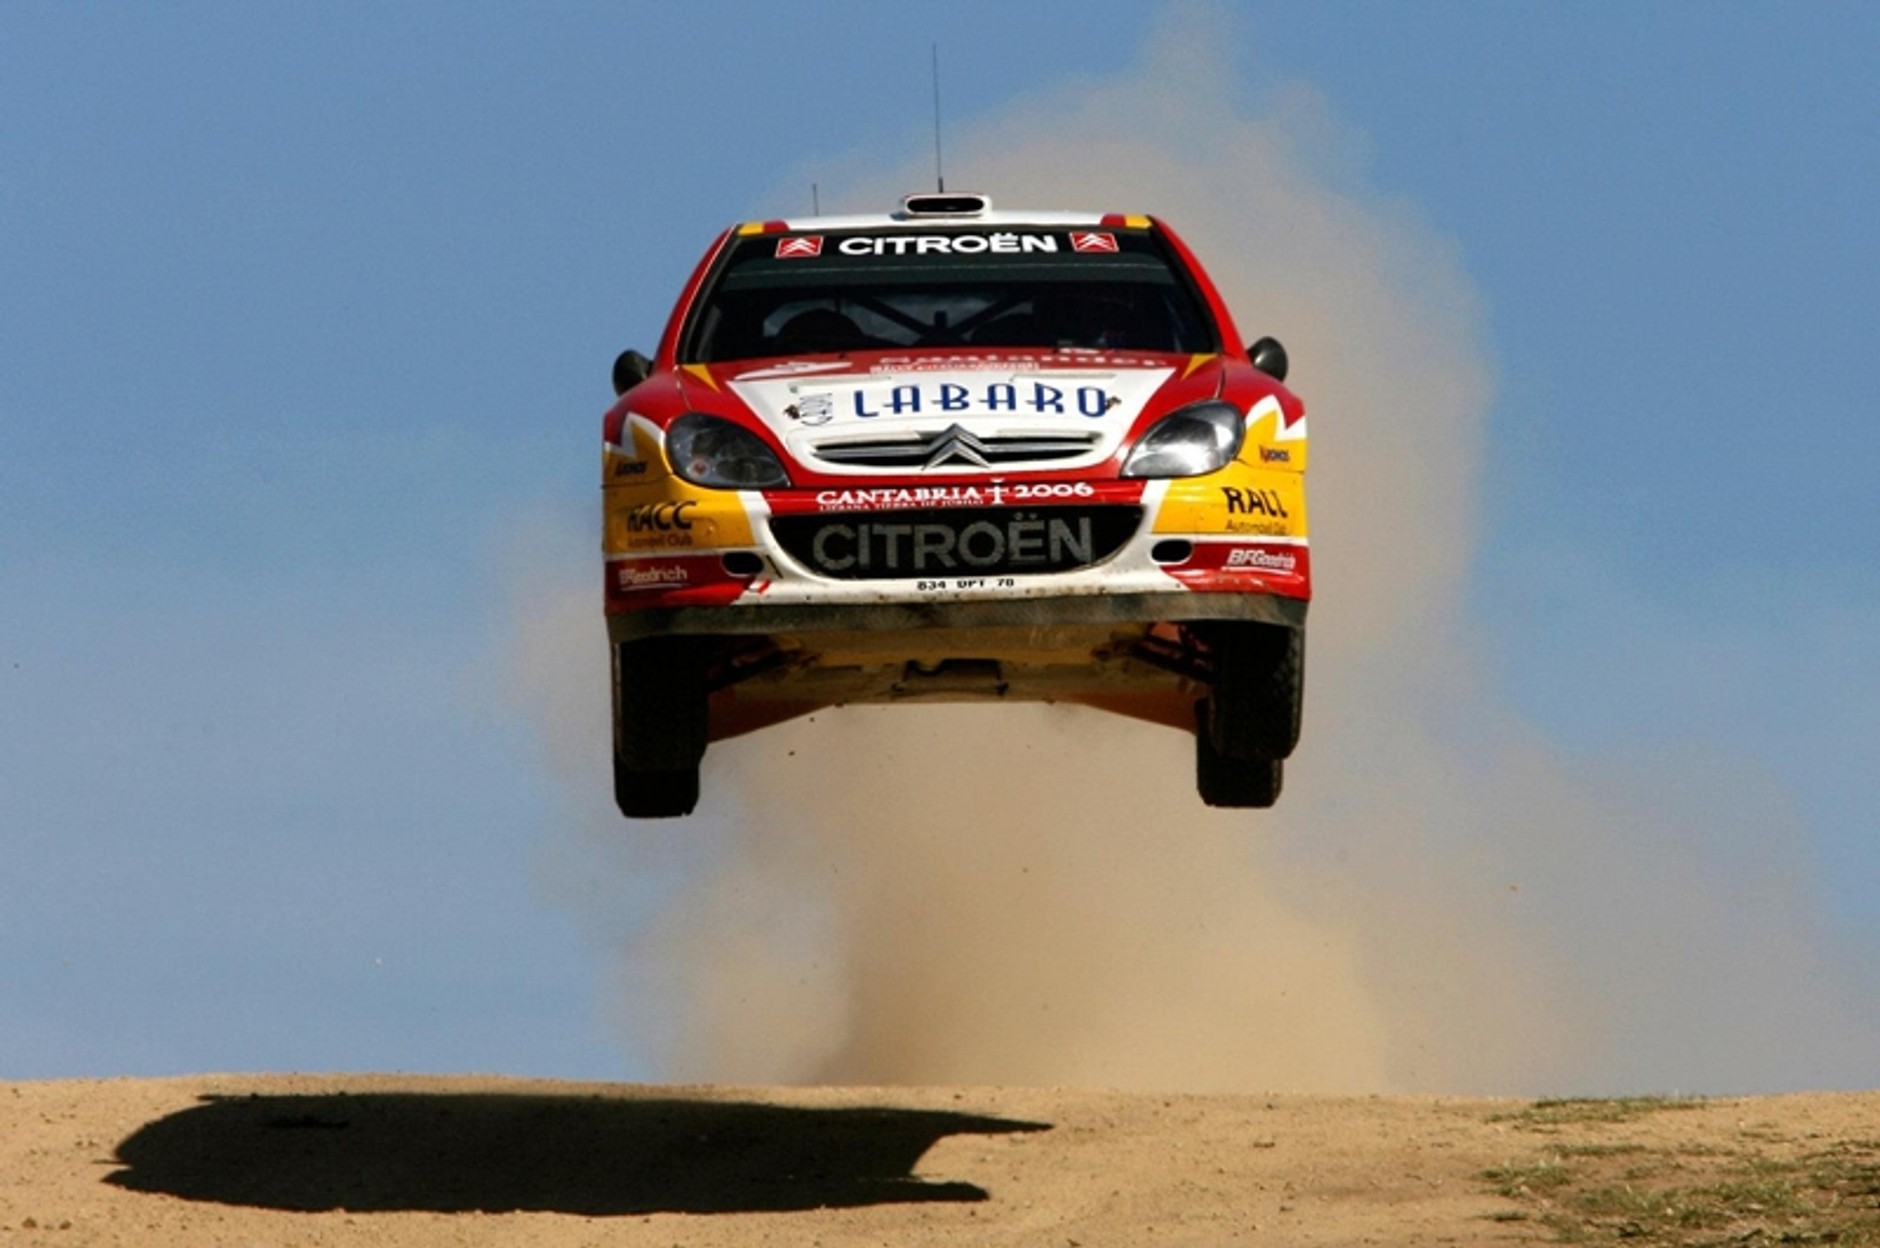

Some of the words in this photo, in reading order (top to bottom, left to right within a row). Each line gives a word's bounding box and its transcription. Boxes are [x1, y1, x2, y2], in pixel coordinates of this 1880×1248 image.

[839, 232, 1058, 255] CITROËN
[853, 382, 1106, 418] LABARO
[816, 486, 982, 505] CANTABRIA
[1014, 481, 1094, 498] 2006
[812, 512, 1092, 570] CITROËN
